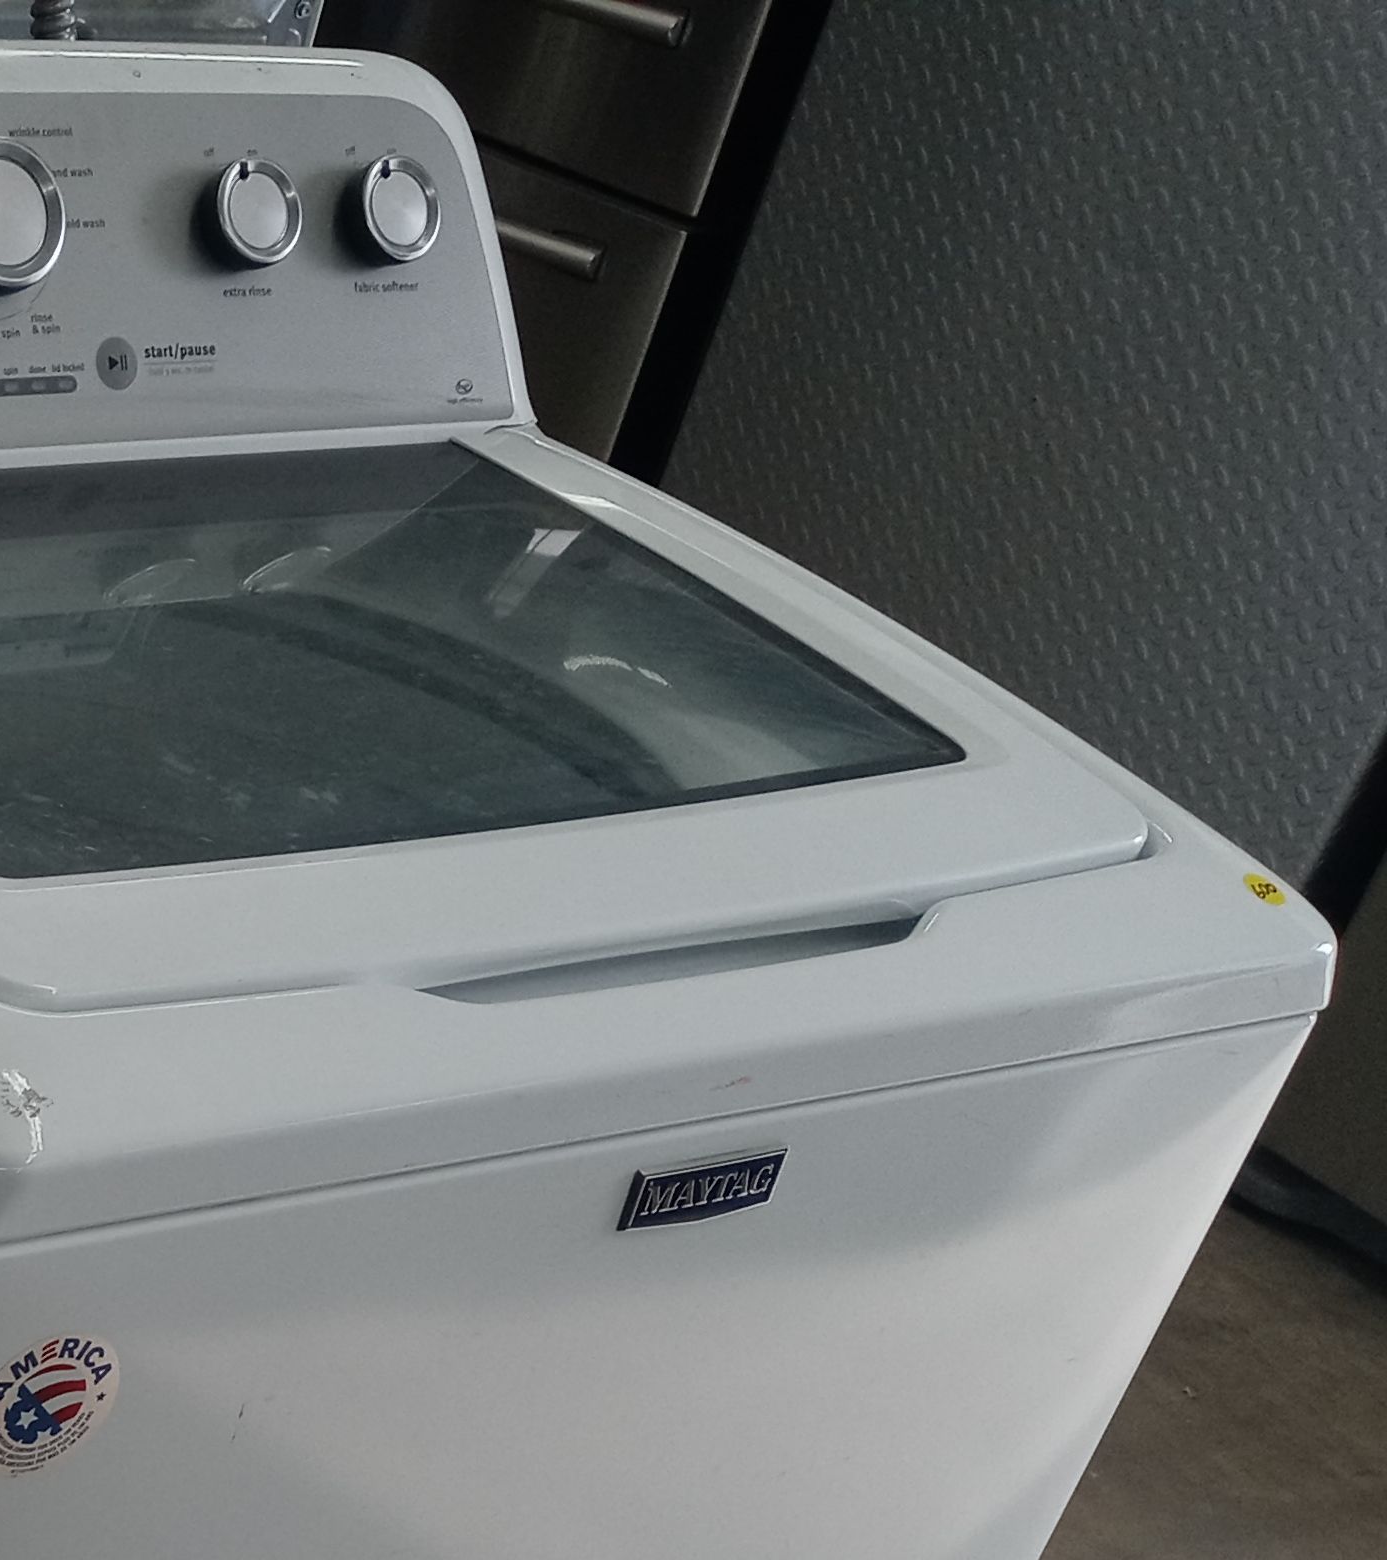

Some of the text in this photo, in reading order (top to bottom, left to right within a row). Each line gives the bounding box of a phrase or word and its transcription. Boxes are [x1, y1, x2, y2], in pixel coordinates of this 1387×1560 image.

[69, 168, 94, 177] wash
[82, 218, 106, 229] wash
[223, 285, 272, 298] extra rinse
[353, 280, 419, 294] fabric softener
[31, 313, 53, 323] rinse
[1, 328, 21, 340] spin
[32, 323, 61, 335] & spin
[144, 342, 217, 360] start/pause
[639, 1162, 775, 1217] MAYTAG
